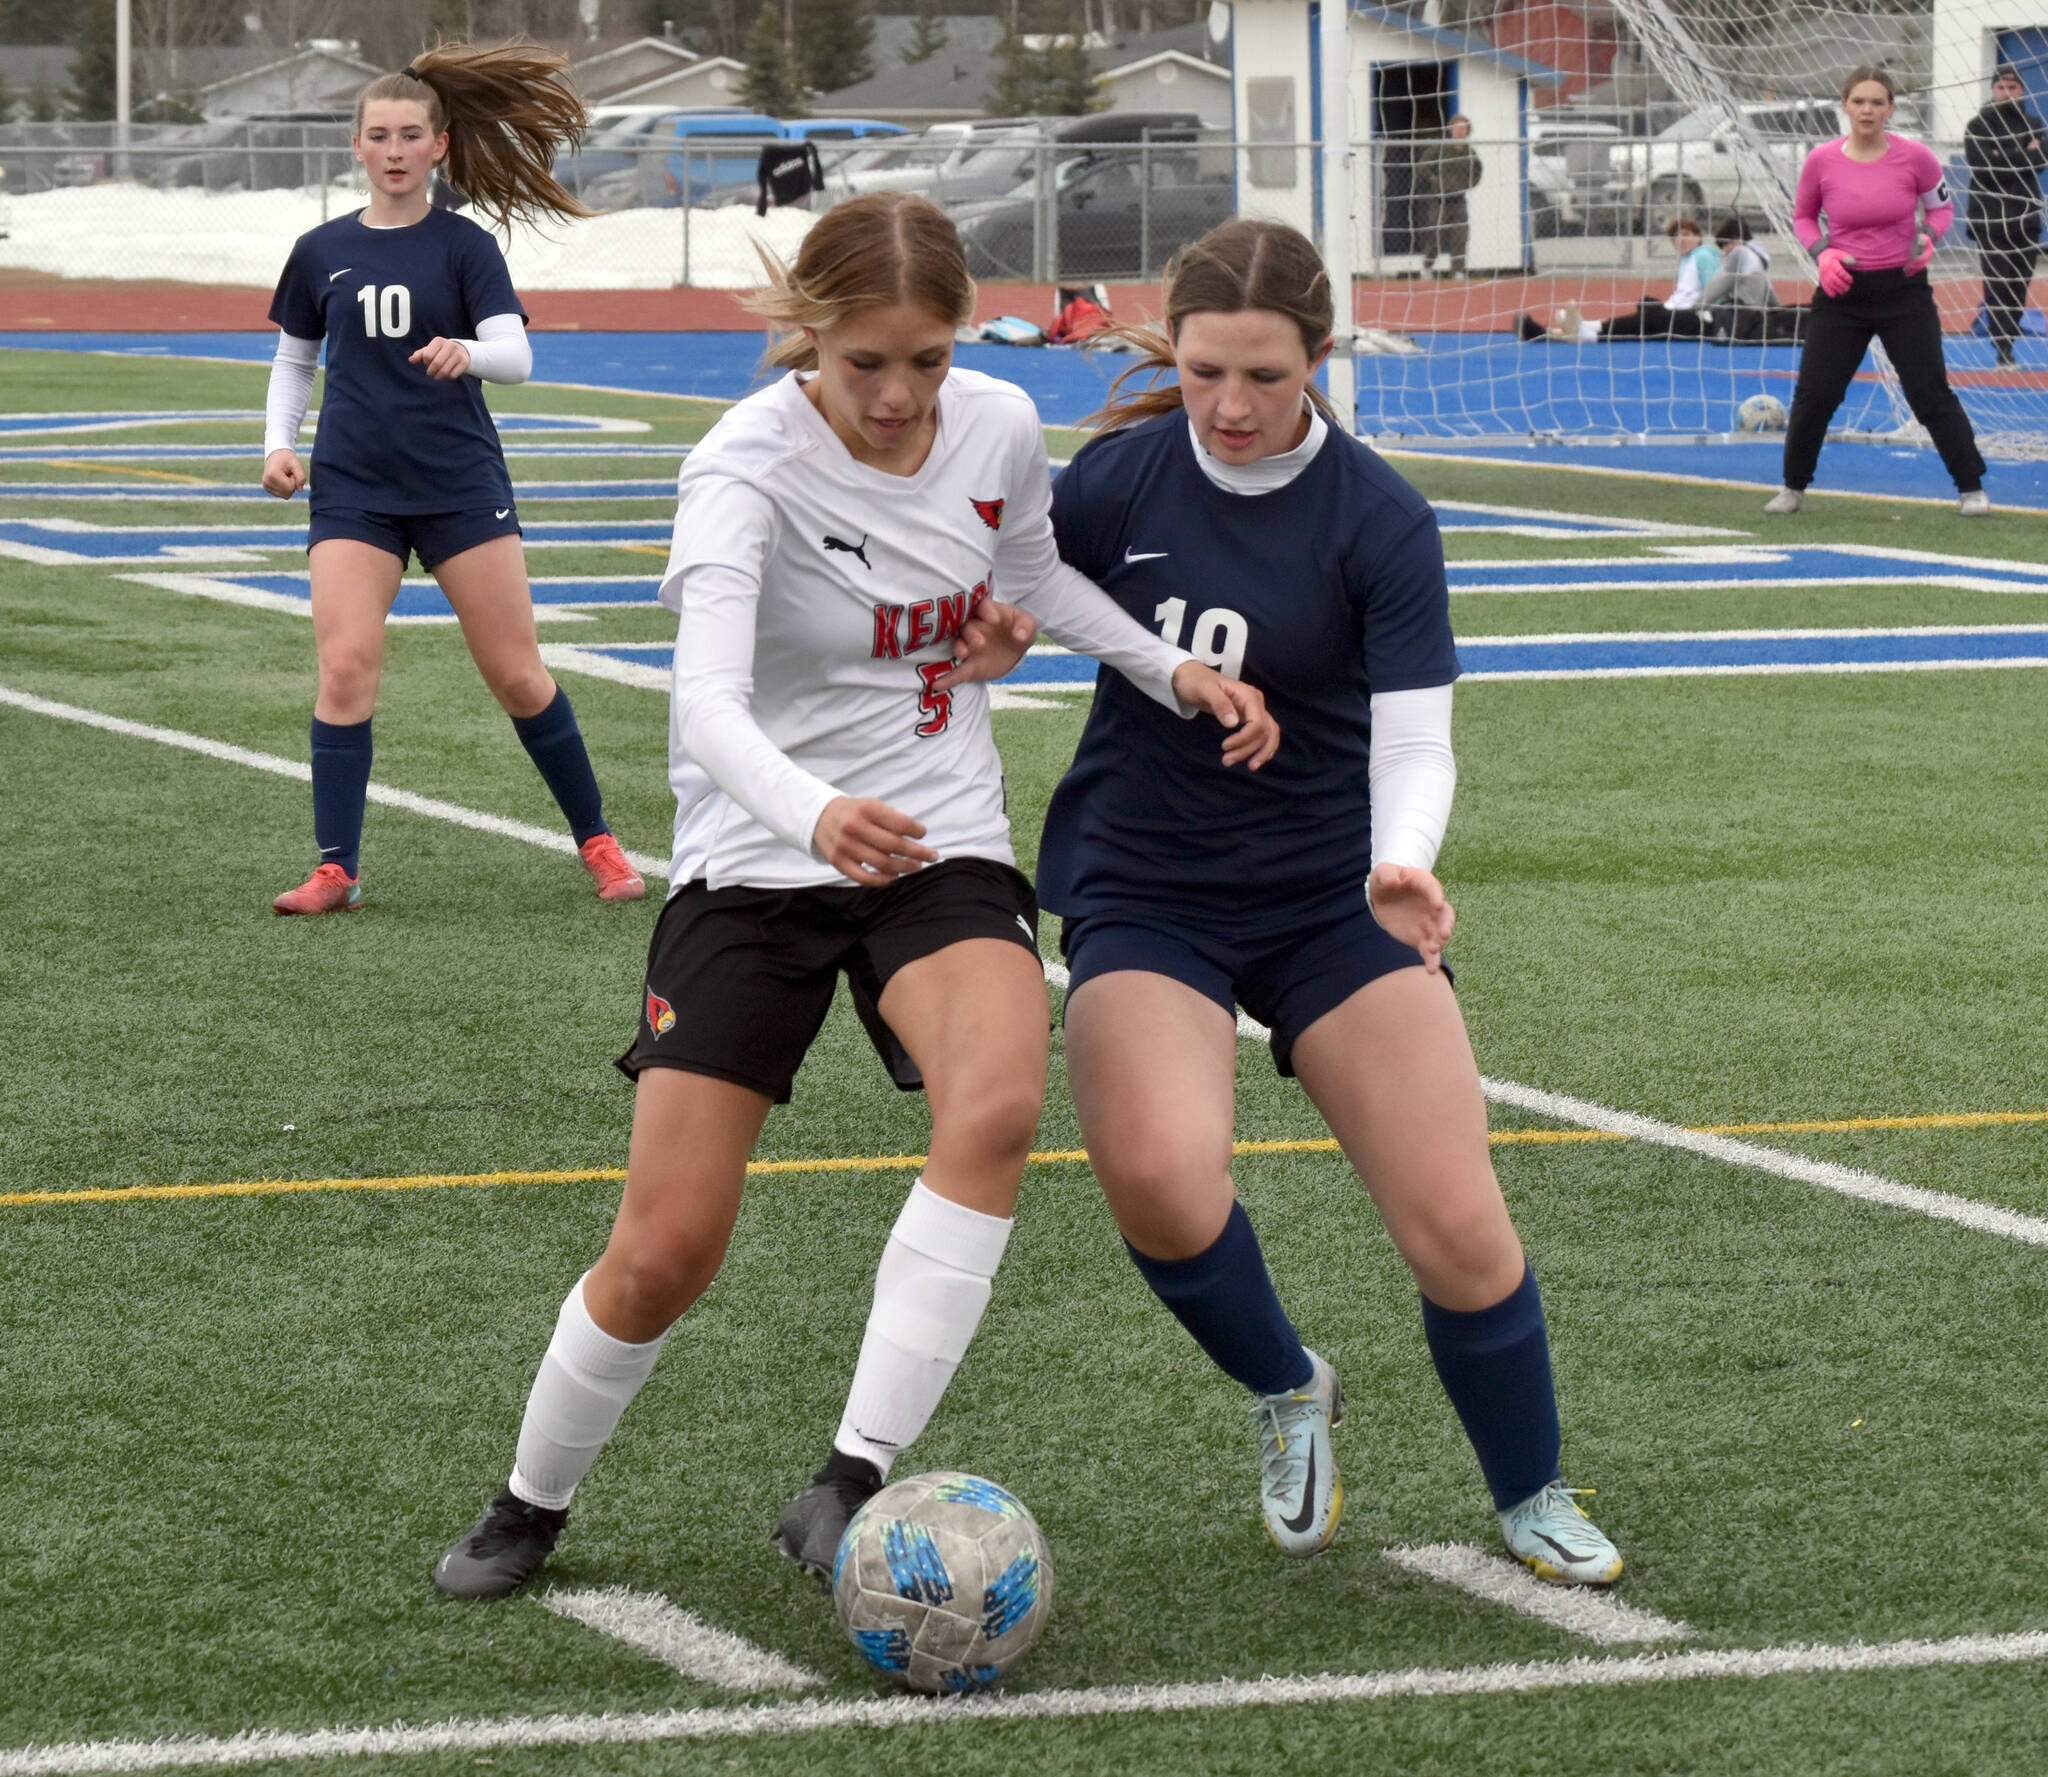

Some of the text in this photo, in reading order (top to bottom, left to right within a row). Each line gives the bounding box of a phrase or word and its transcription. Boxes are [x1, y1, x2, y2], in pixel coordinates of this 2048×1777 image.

[357, 285, 411, 338] 10
[1154, 596, 1248, 681] 19
[914, 657, 956, 738] 5
